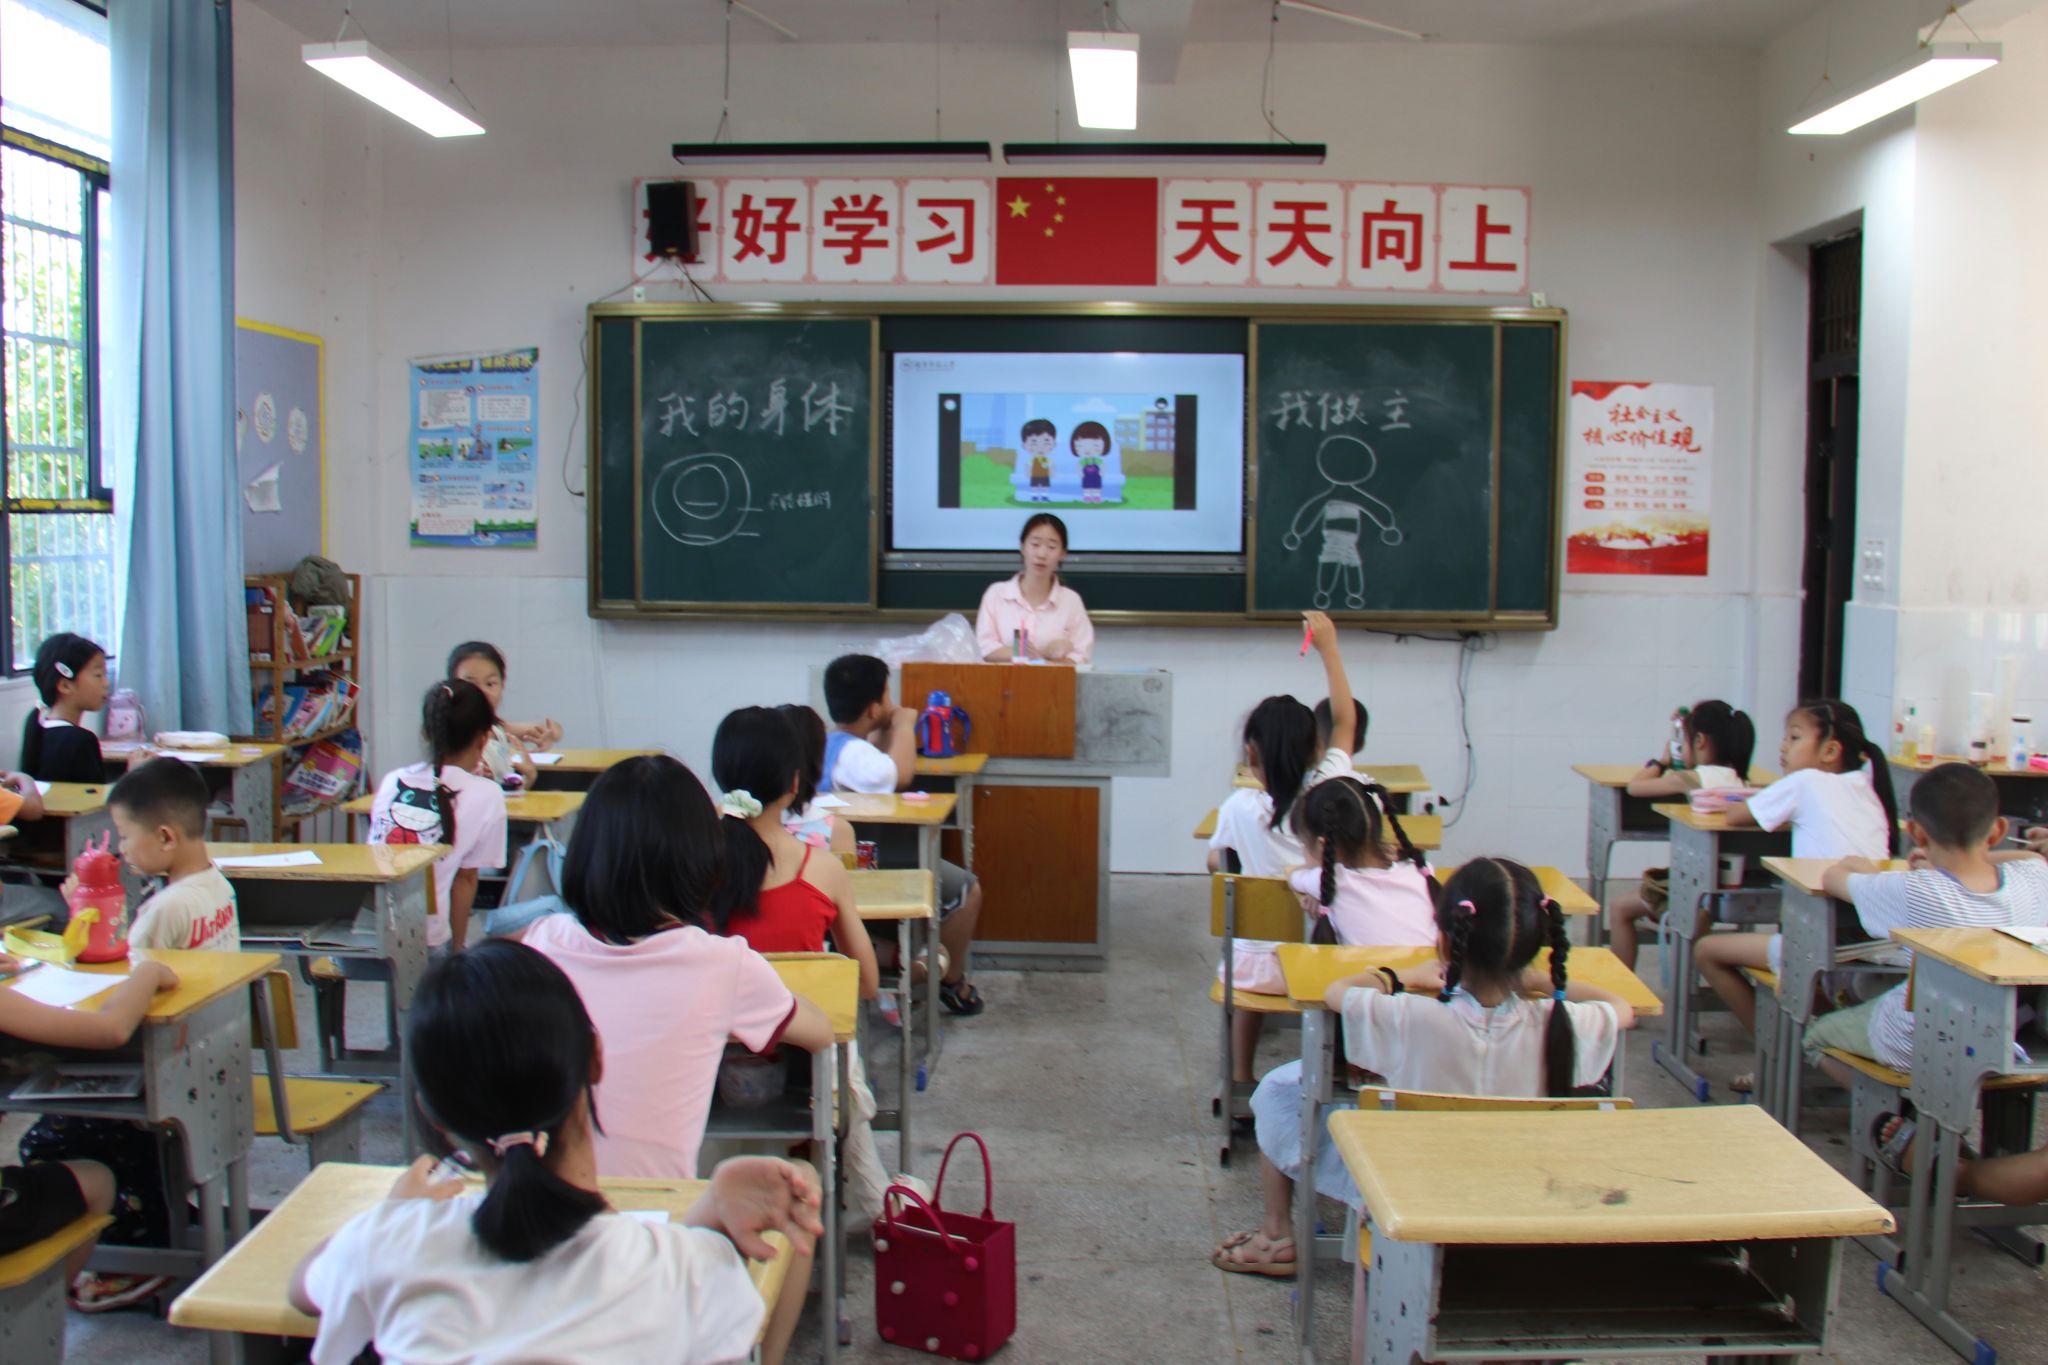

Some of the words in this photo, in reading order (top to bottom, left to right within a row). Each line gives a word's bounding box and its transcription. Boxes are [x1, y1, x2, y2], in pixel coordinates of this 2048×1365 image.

[1173, 198, 1518, 273] 天天向上
[658, 376, 855, 438] 我的身体
[1270, 388, 1412, 432] 我做主
[1608, 402, 1682, 426] 社会主义
